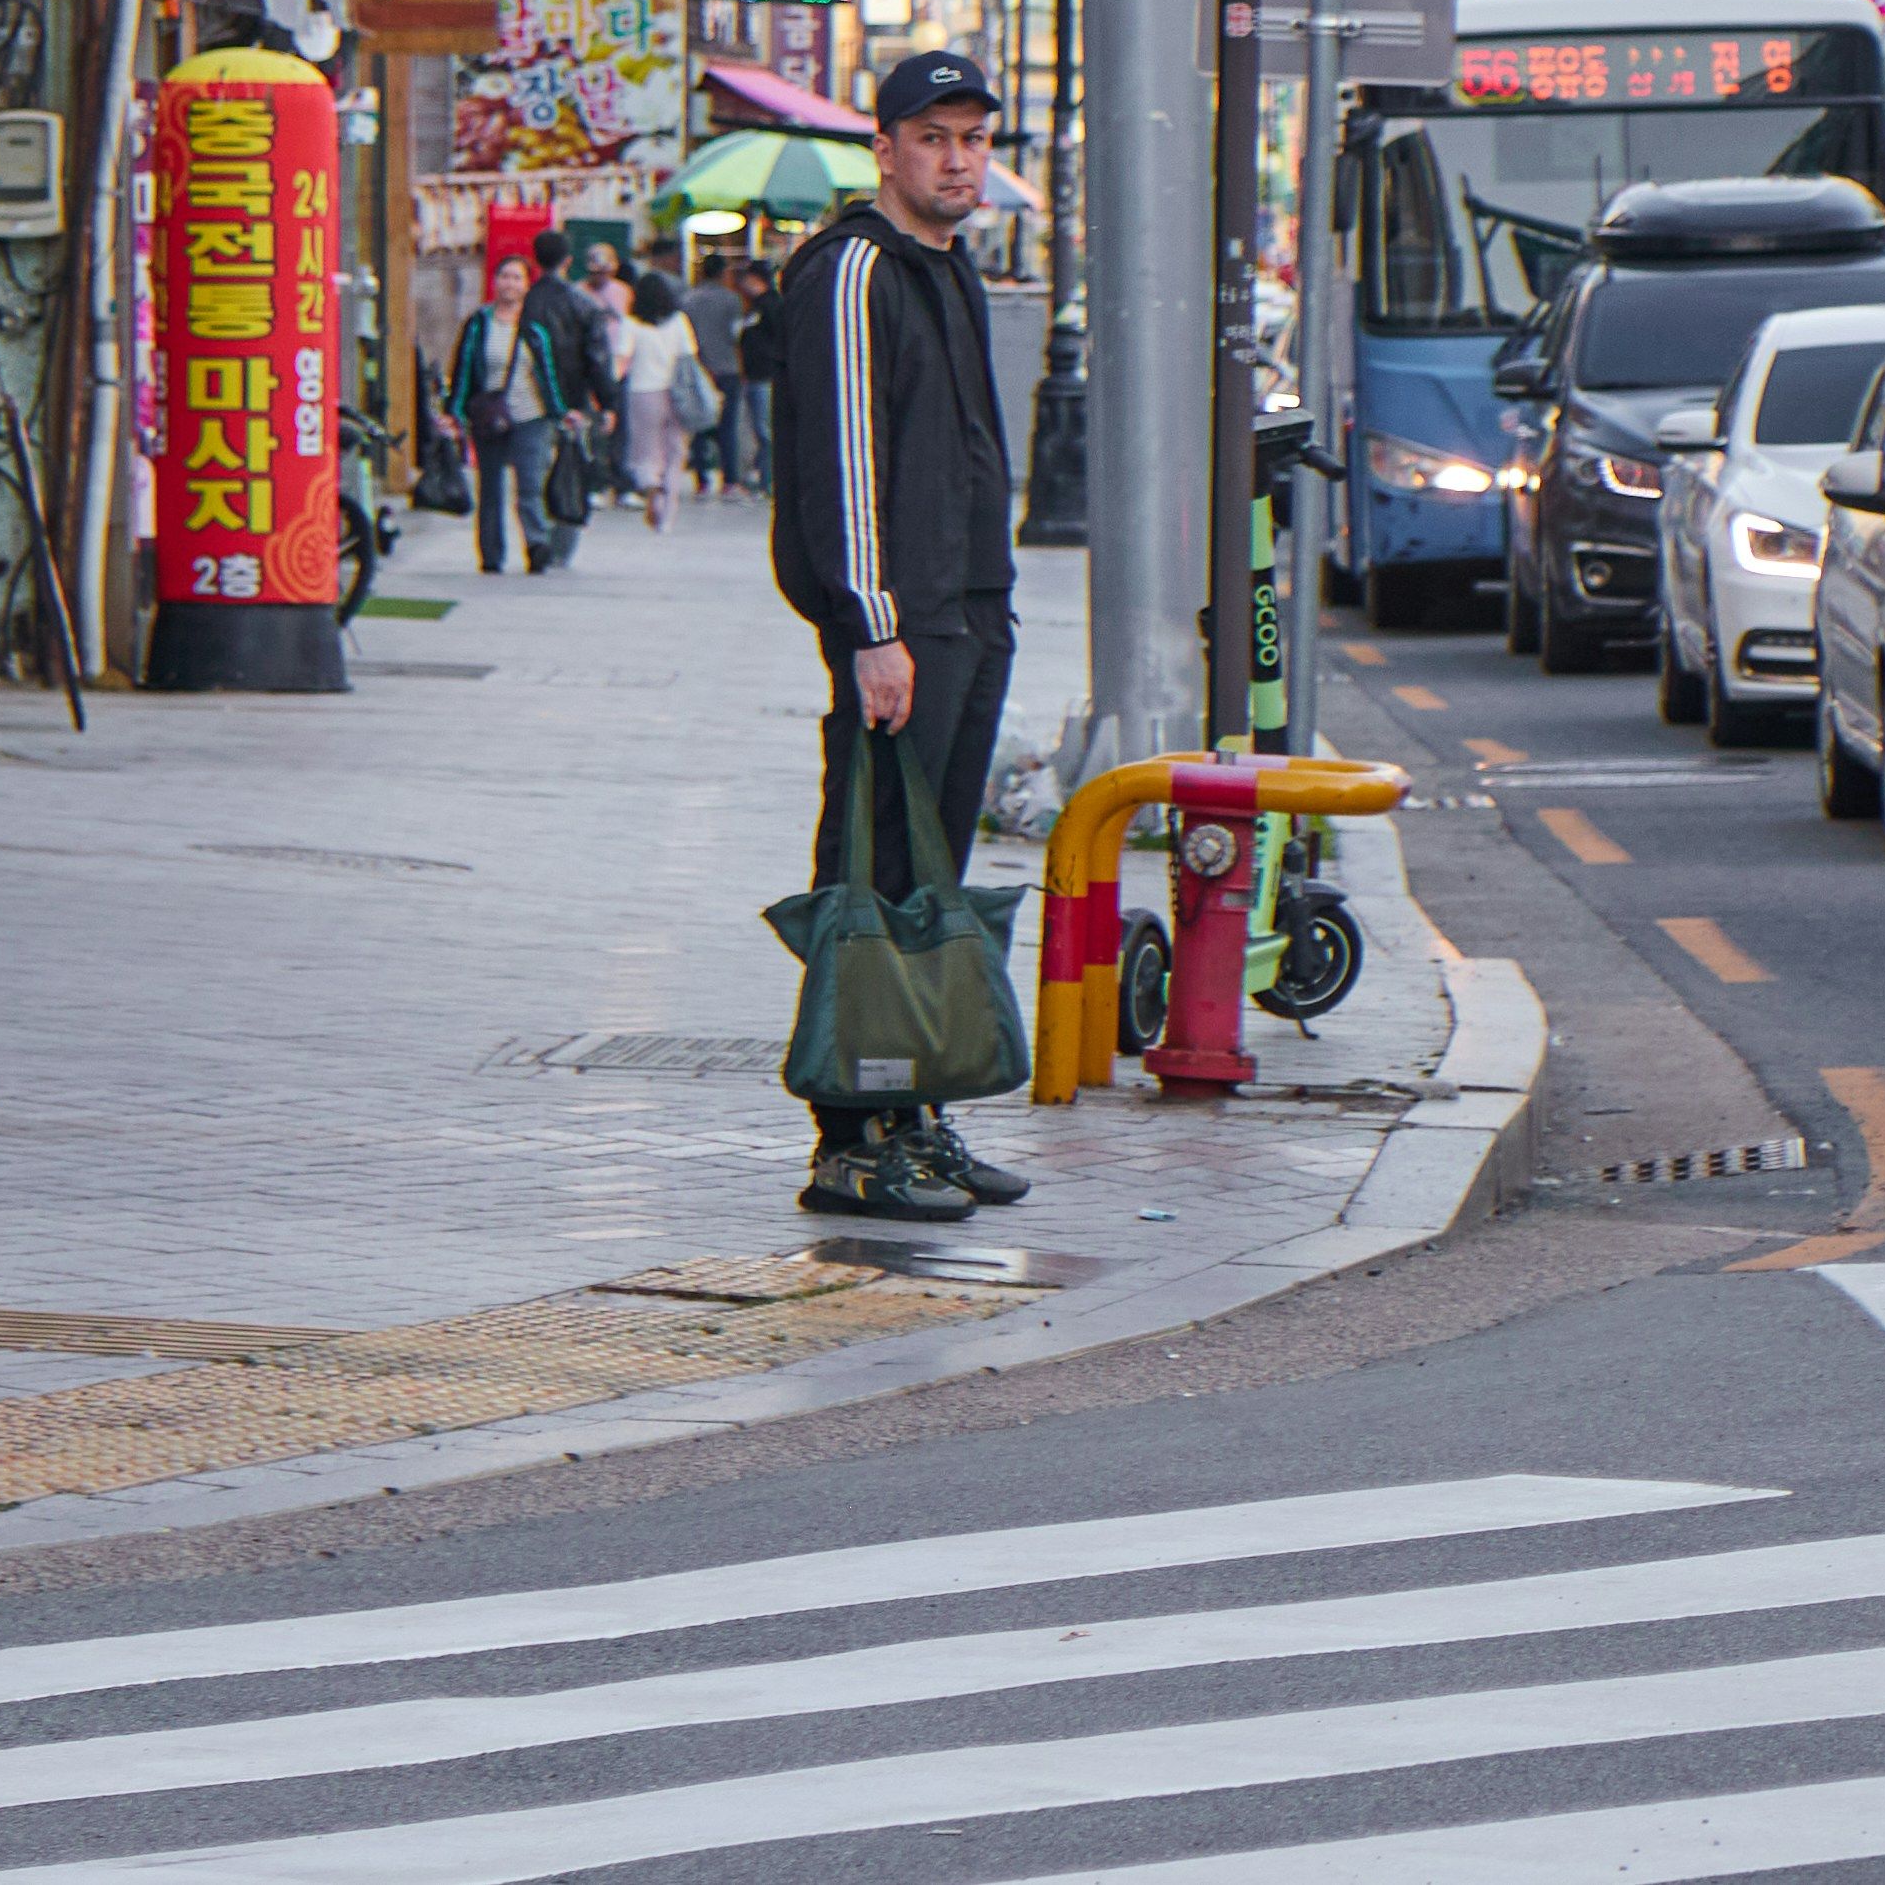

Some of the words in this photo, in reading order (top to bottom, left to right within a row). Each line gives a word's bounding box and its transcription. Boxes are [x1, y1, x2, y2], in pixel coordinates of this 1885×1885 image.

[185, 100, 275, 340] 중국전통
[293, 169, 330, 336] 24시간
[185, 356, 279, 535] 마사지
[295, 347, 325, 457] 영업
[192, 555, 263, 599] 2층
[1253, 584, 1280, 668] GCOO
